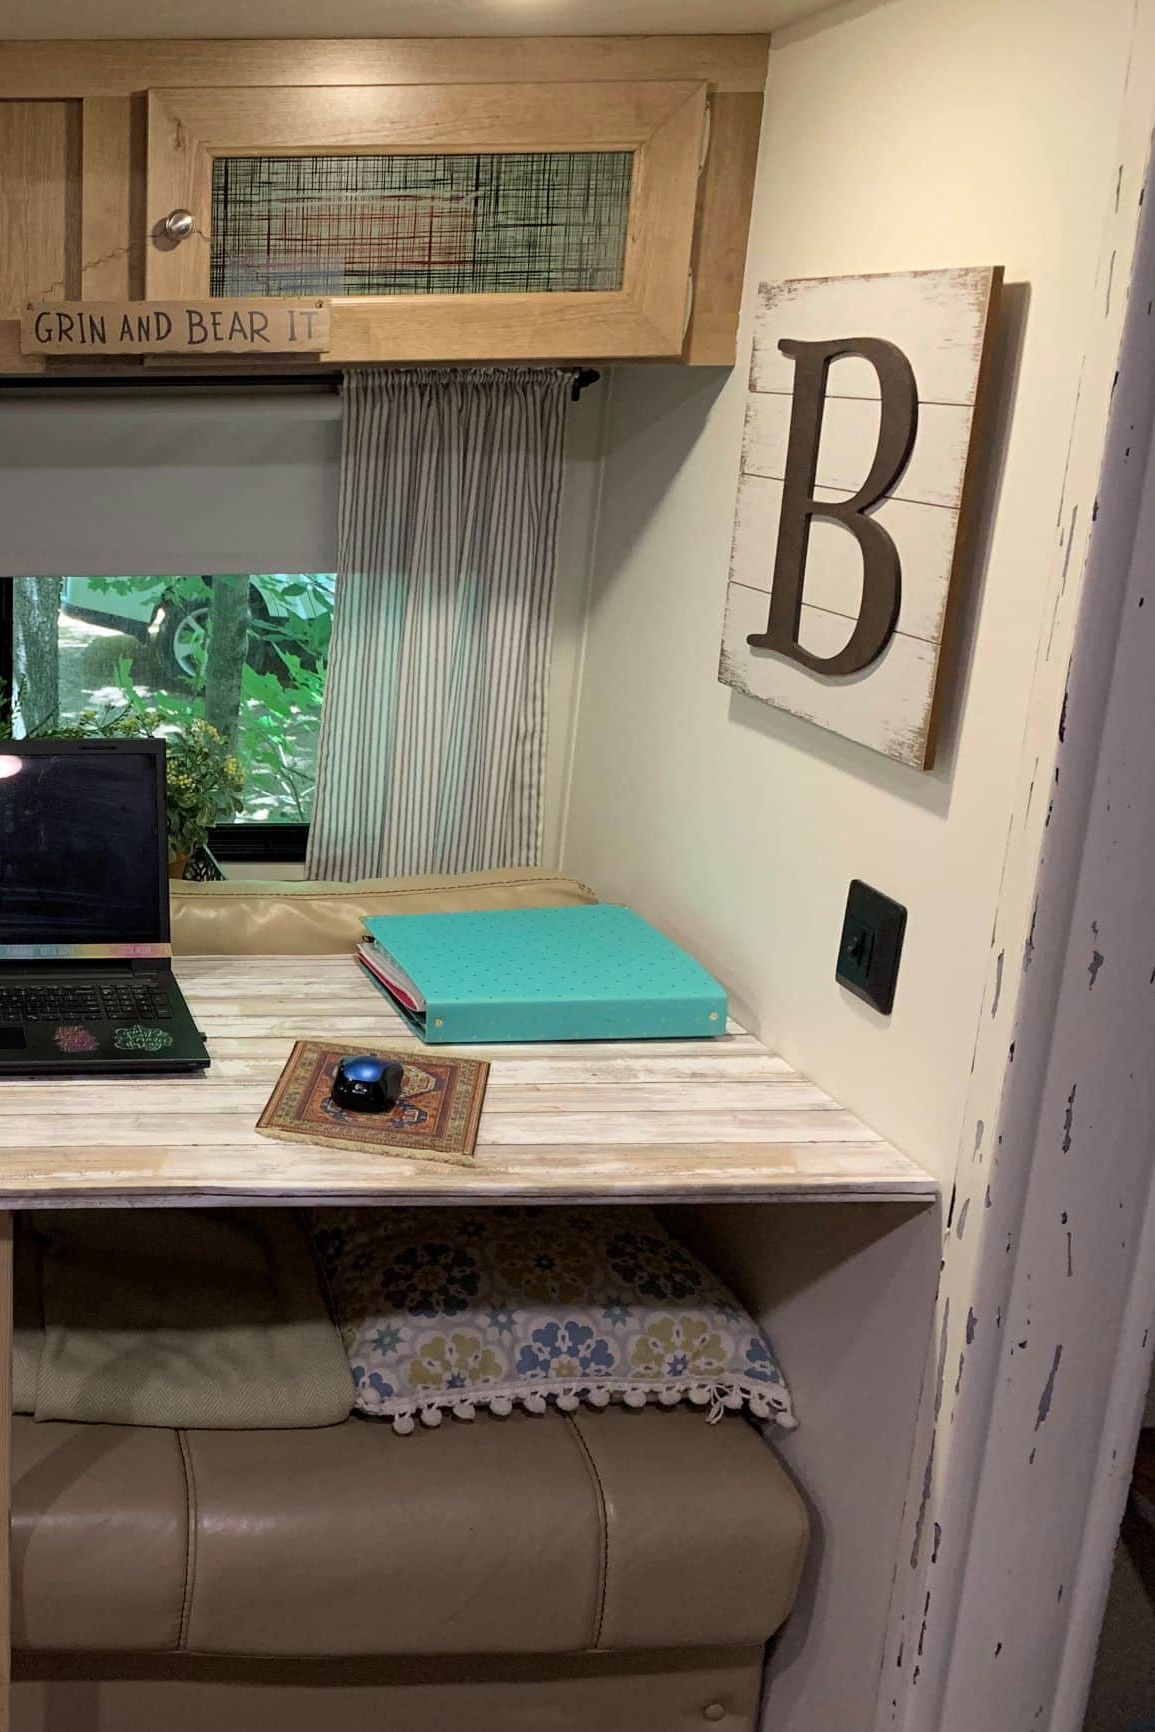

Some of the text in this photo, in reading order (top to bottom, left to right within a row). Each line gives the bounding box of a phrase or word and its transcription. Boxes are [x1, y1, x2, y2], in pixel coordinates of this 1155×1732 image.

[34, 309, 319, 345] GRIN AND BEAR IT
[746, 336, 919, 677] B
